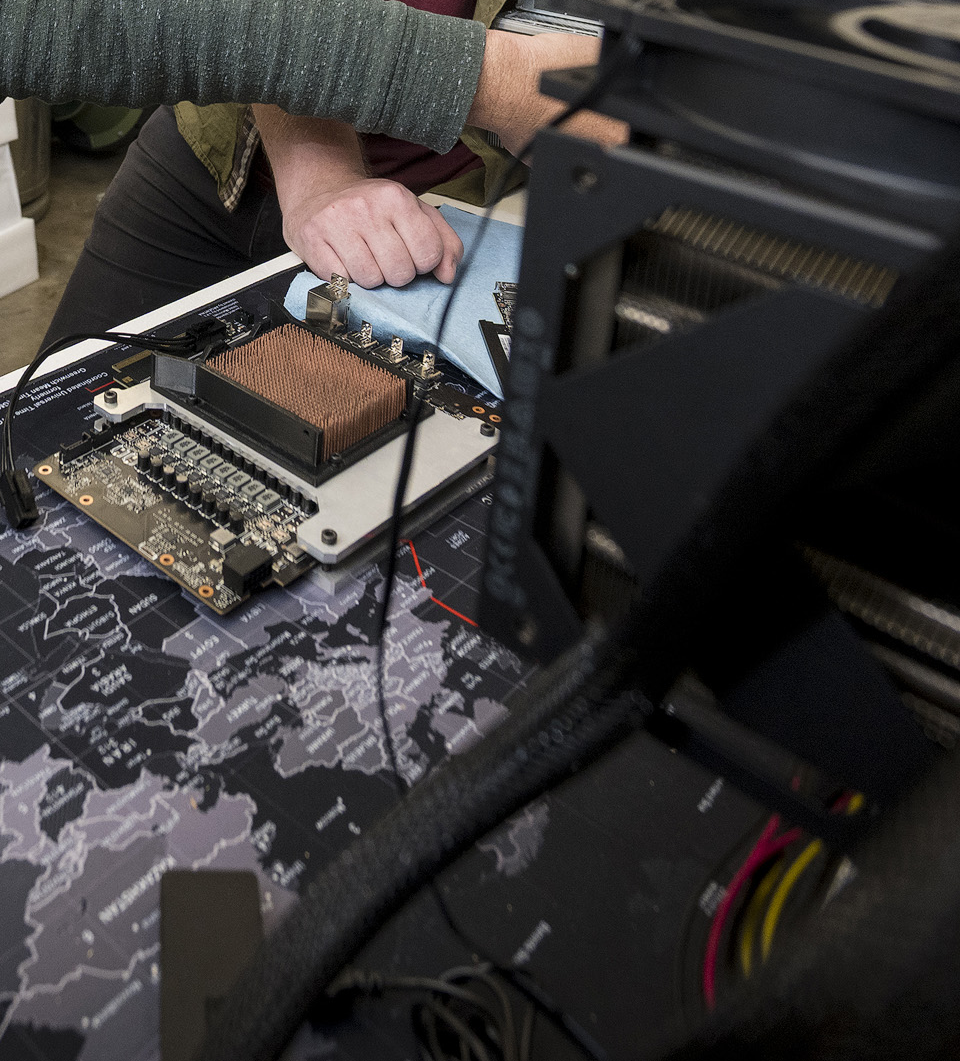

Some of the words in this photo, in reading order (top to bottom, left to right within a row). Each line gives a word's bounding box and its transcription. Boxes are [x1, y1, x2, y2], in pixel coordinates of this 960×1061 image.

[50, 365, 85, 386] Greenwich
[66, 370, 107, 393] Coordinated
[30, 382, 50, 394] Mean
[30, 384, 60, 401] formerly
[33, 389, 66, 408] Universal
[14, 404, 34, 416] Time
[34, 548, 66, 572] TANZANIA
[53, 579, 77, 598] KENYA
[127, 591, 158, 616] SUDAN
[237, 601, 265, 624] LIBYA
[64, 603, 98, 629] ETHIOPIA
[188, 633, 219, 659] EGYPT
[60, 653, 87, 675] YEMEN
[89, 663, 128, 693] ARABIA
[100, 671, 133, 696] SAUDI
[223, 694, 257, 722] TURKEY
[100, 736, 137, 767] IRAN
